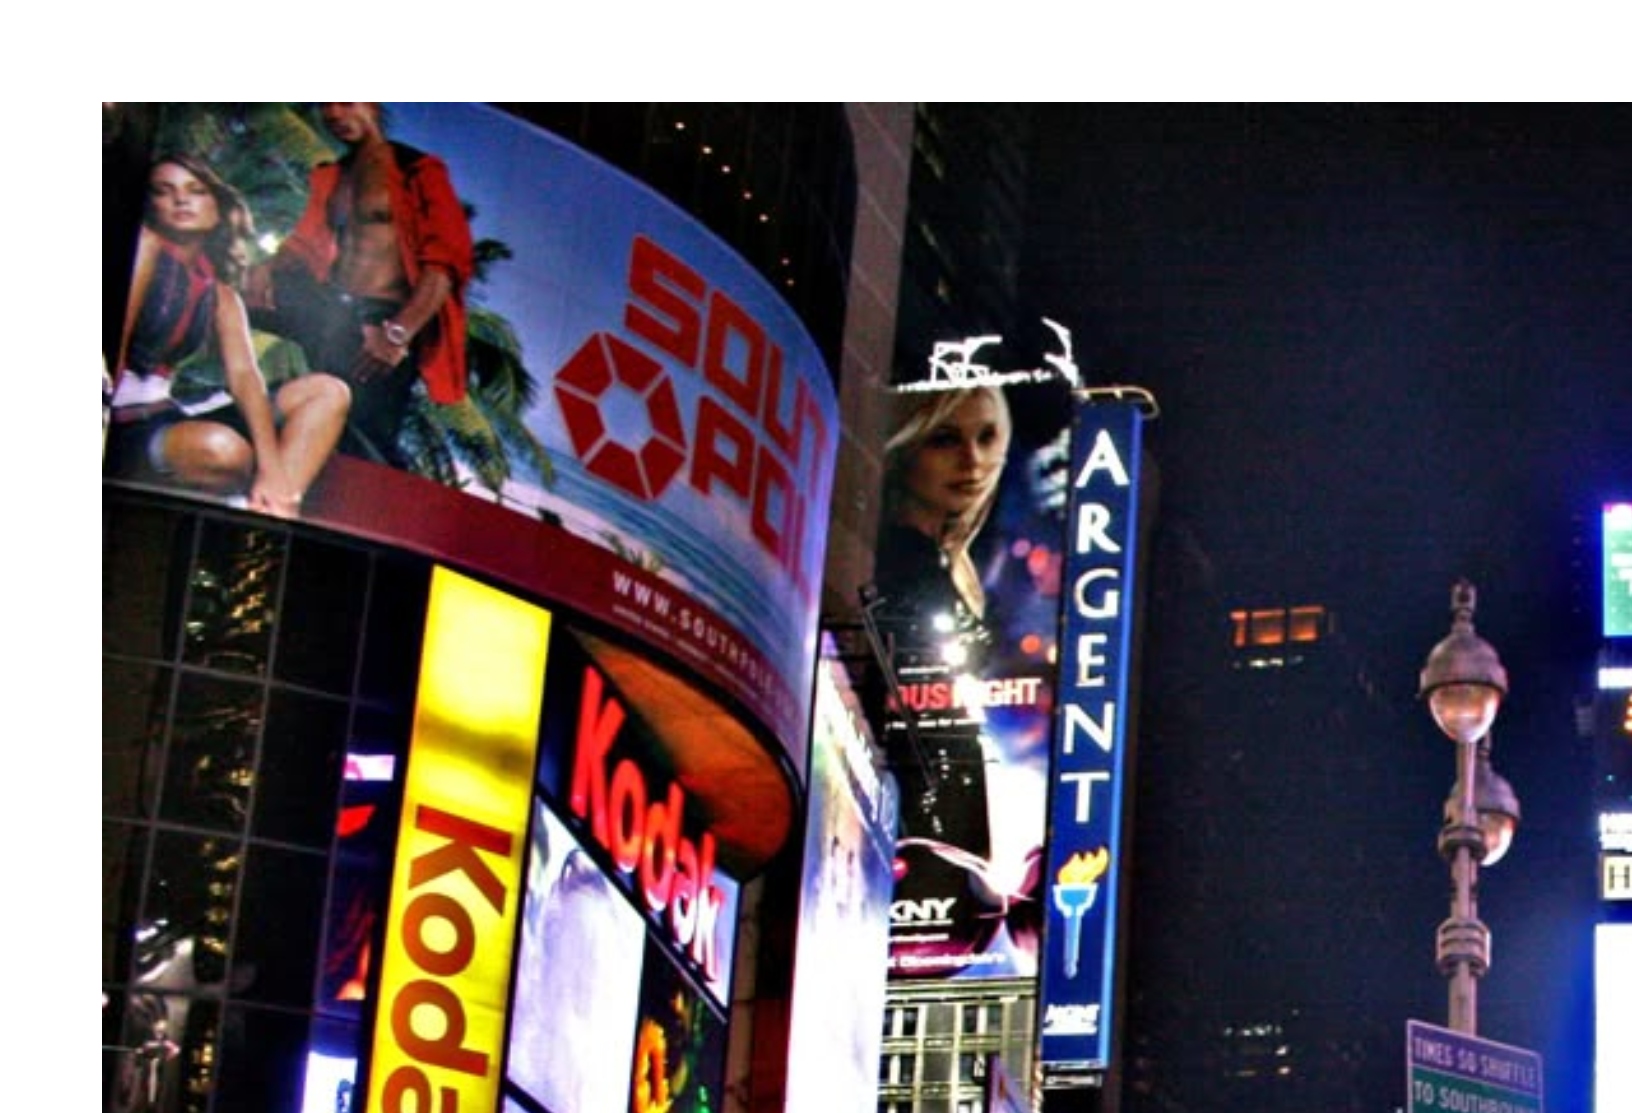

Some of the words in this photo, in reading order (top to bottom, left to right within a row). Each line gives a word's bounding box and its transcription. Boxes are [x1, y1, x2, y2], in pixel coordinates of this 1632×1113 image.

[1060, 428, 1130, 824] ARGENT
[570, 665, 726, 984] Kodak
[1414, 1037, 1450, 1067] TIMES
[1480, 1054, 1537, 1089] SHUTTLE
[1414, 1080, 1434, 1104] TO
